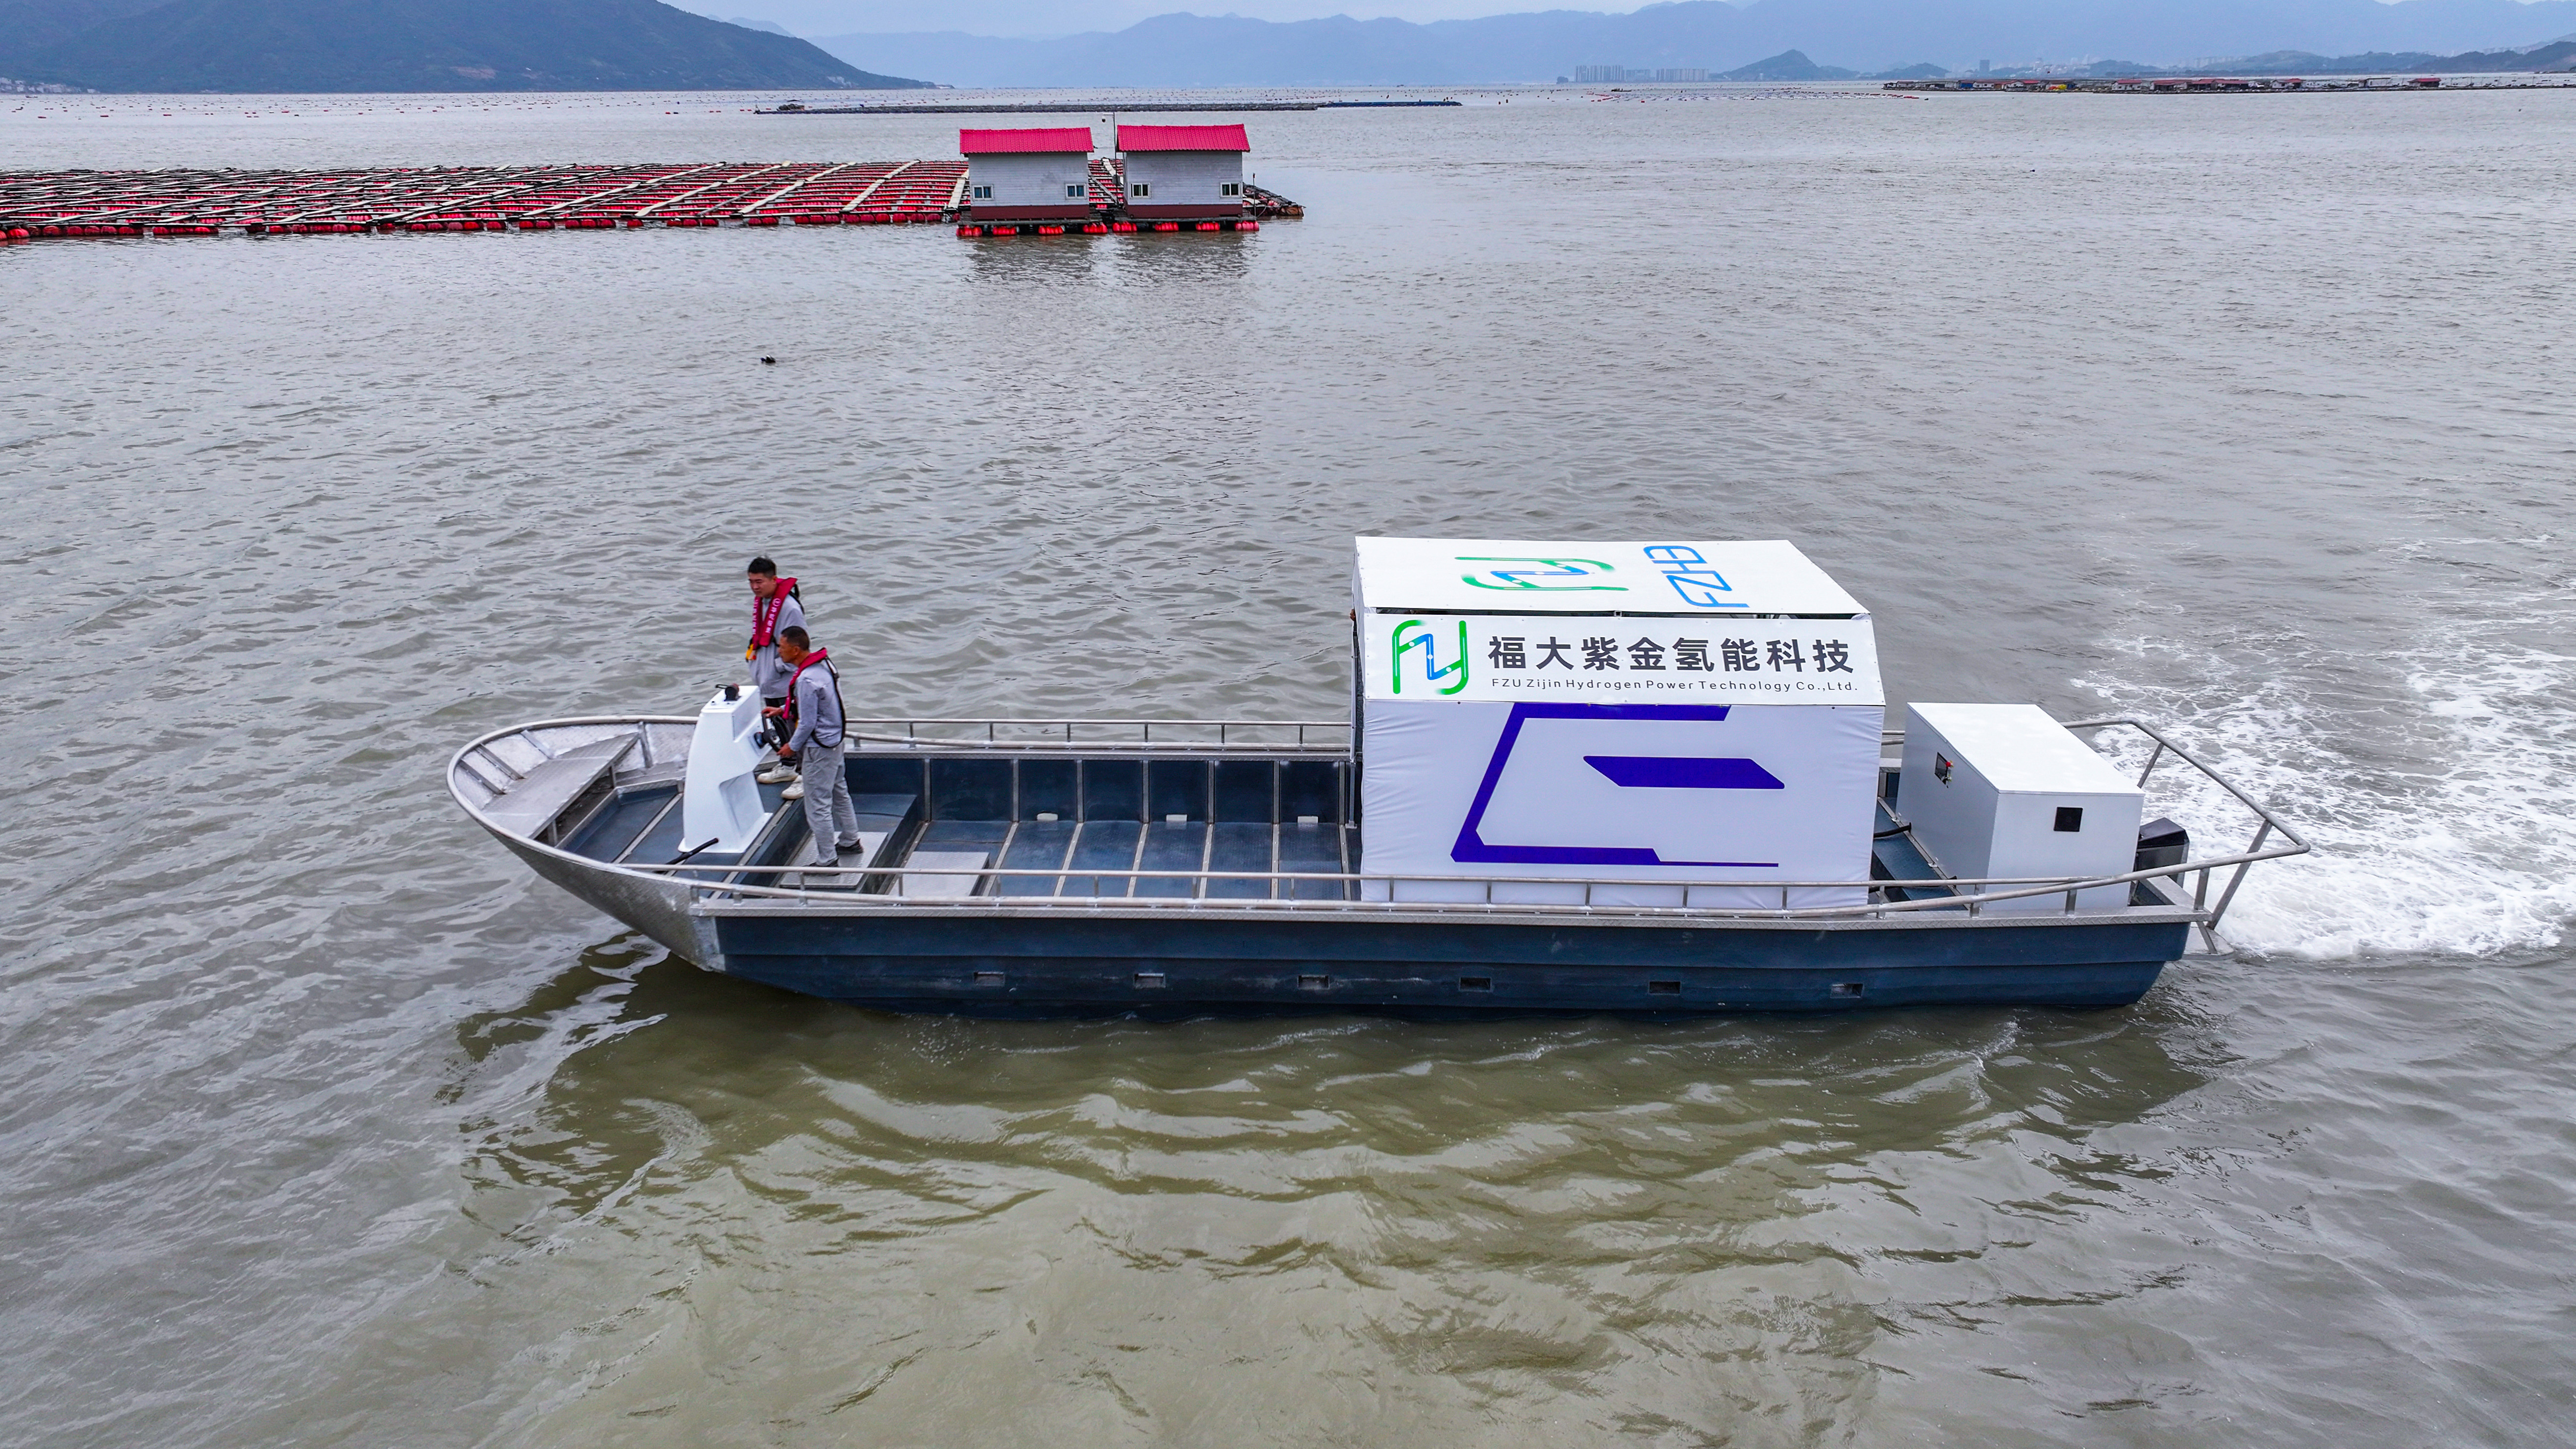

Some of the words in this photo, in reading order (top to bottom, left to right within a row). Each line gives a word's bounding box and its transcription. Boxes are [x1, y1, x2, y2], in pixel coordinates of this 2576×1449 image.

[1488, 636, 1853, 673] 福大紫金氢能科技
[1492, 678, 1521, 687] FZU
[1526, 679, 1561, 689] Zijin
[1566, 679, 1641, 690] Hydrogen
[1646, 680, 1693, 689] Power
[1698, 680, 1790, 692] Technology
[1796, 681, 1857, 692] Co.,Ltd.
